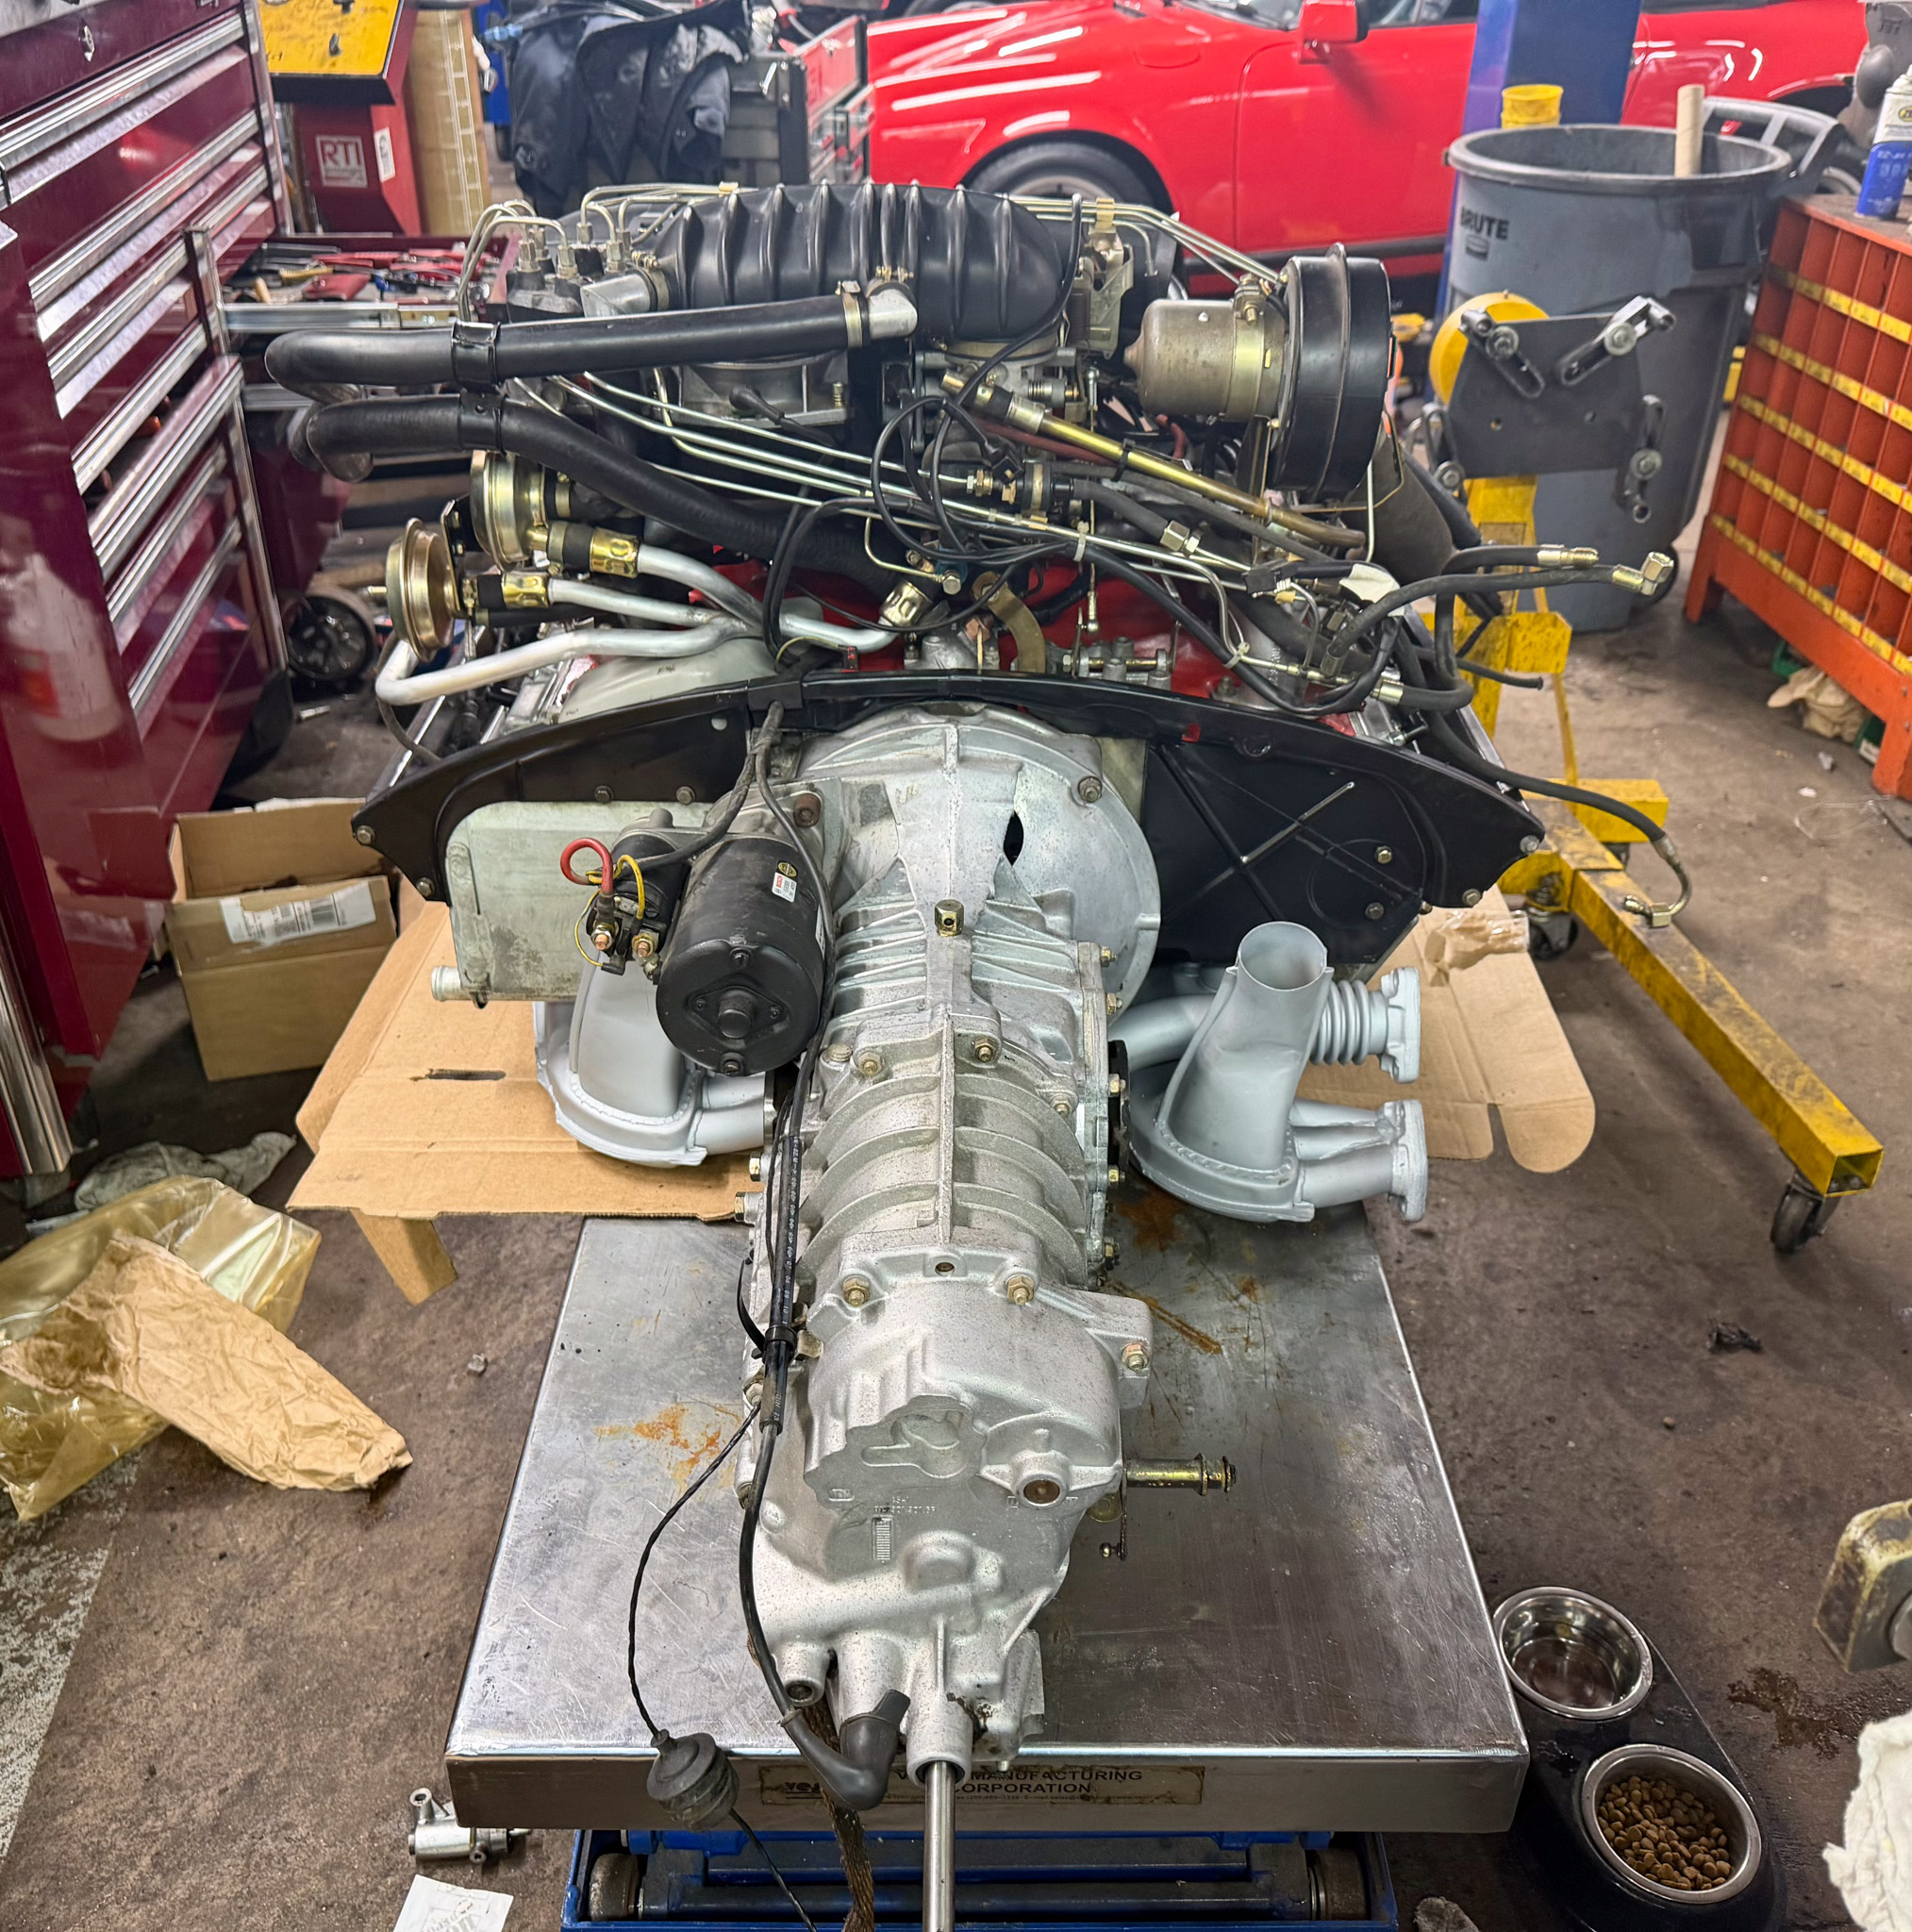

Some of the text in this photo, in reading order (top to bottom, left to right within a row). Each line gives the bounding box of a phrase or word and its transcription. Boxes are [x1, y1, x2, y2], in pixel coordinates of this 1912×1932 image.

[321, 140, 361, 167] RTI
[971, 1770, 1142, 1781] MANUFACTURING
[955, 1783, 1091, 1794] ORPORATION
